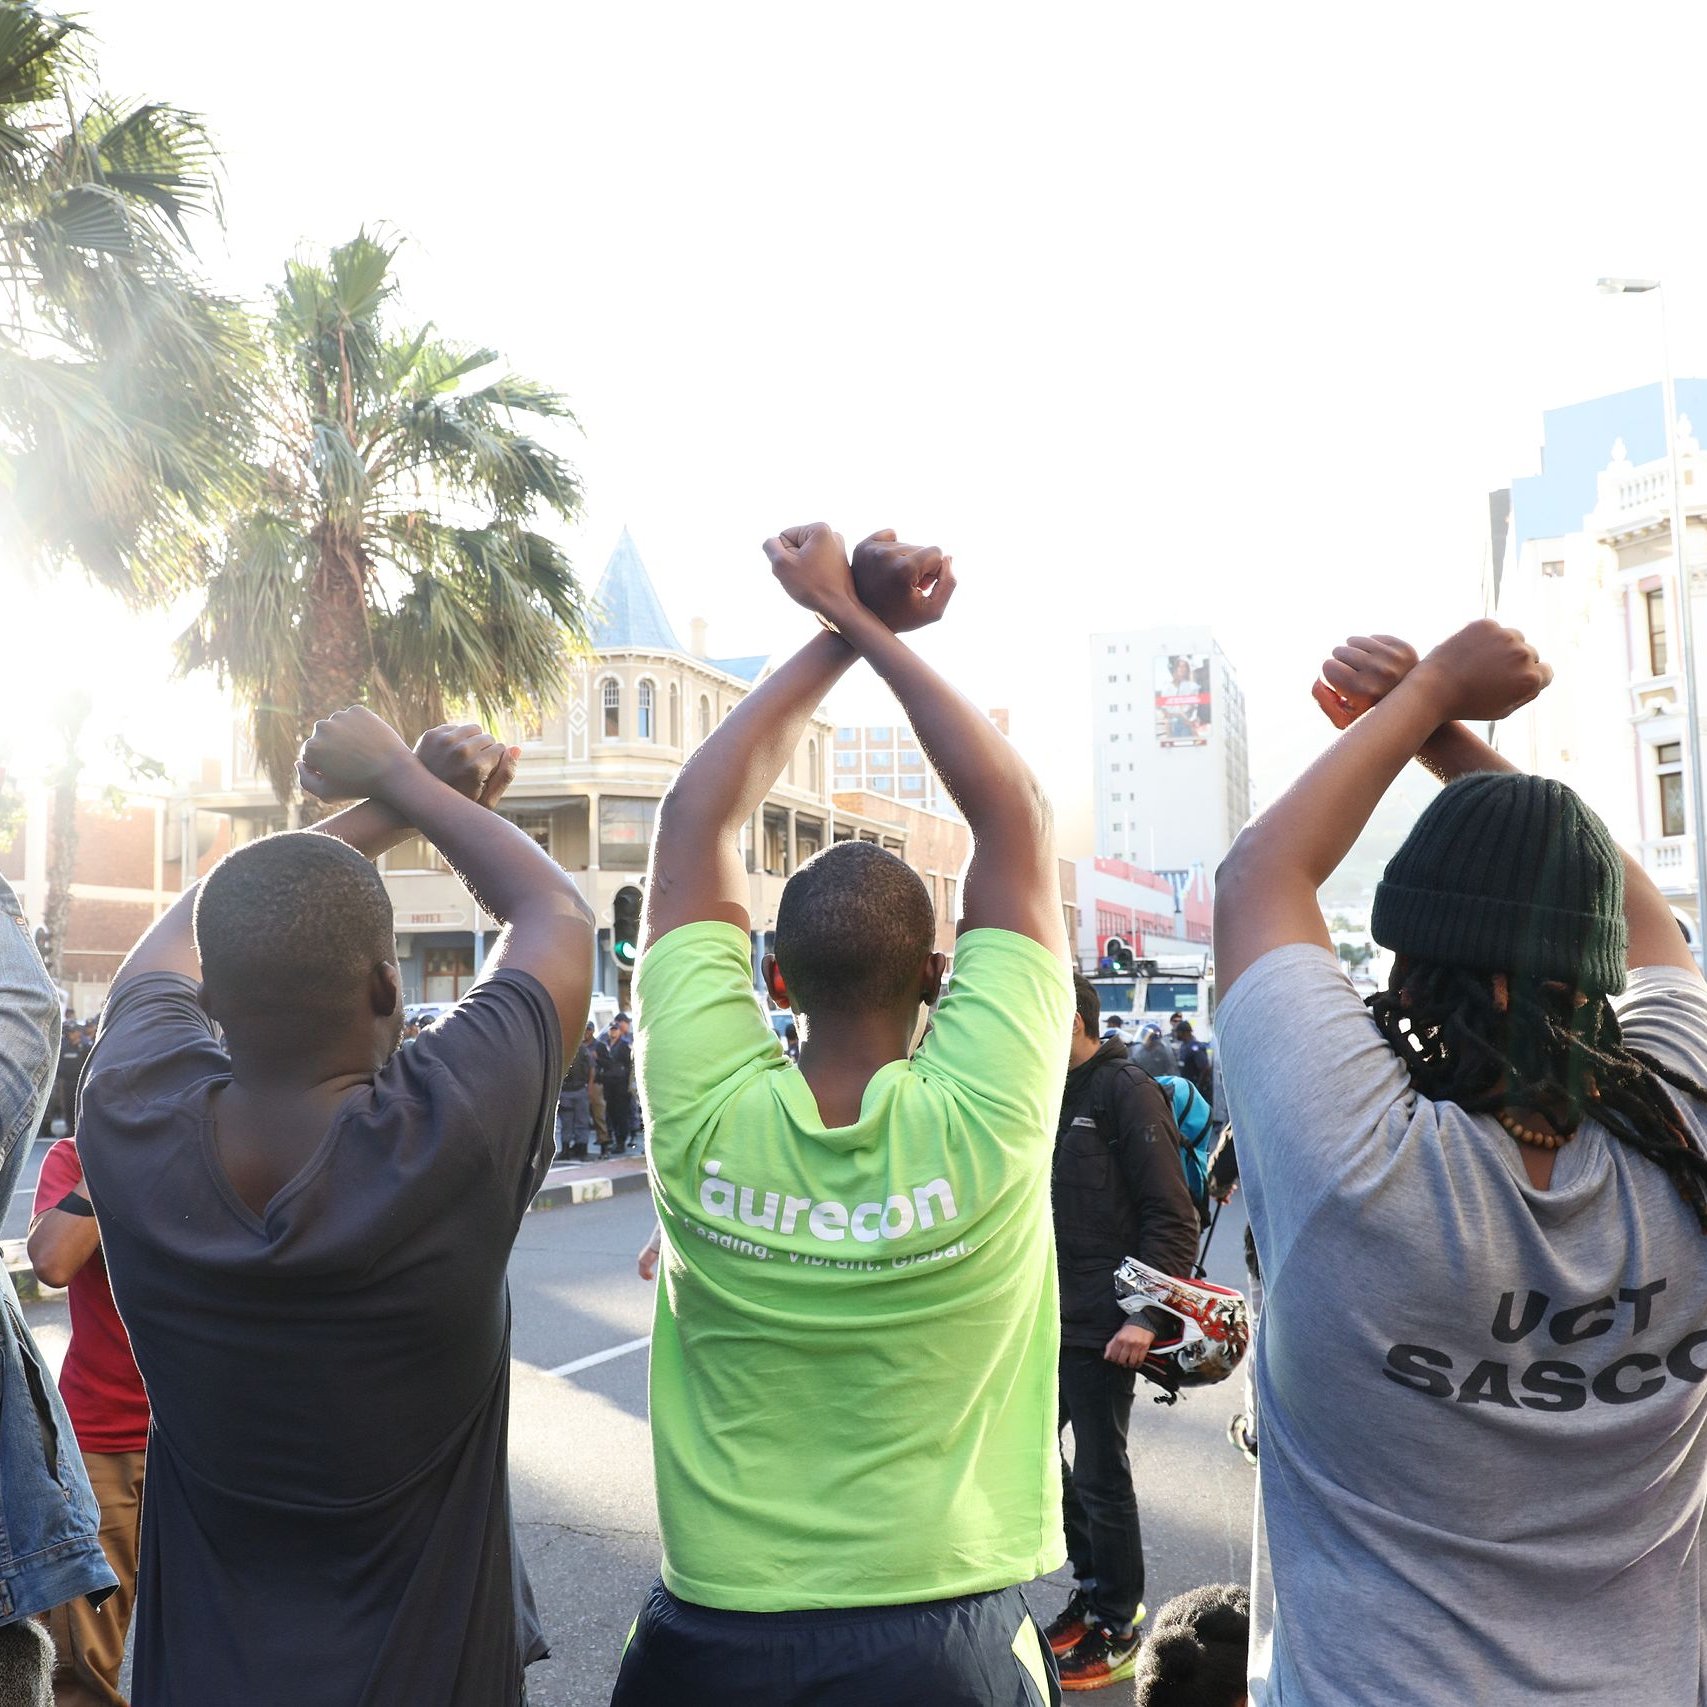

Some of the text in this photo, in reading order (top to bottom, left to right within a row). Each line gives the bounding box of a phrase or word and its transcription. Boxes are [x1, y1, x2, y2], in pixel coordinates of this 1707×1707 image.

[699, 1160, 959, 1243] aurecon
[683, 1217, 775, 1260] eading.
[1491, 1278, 1667, 1346] UCT
